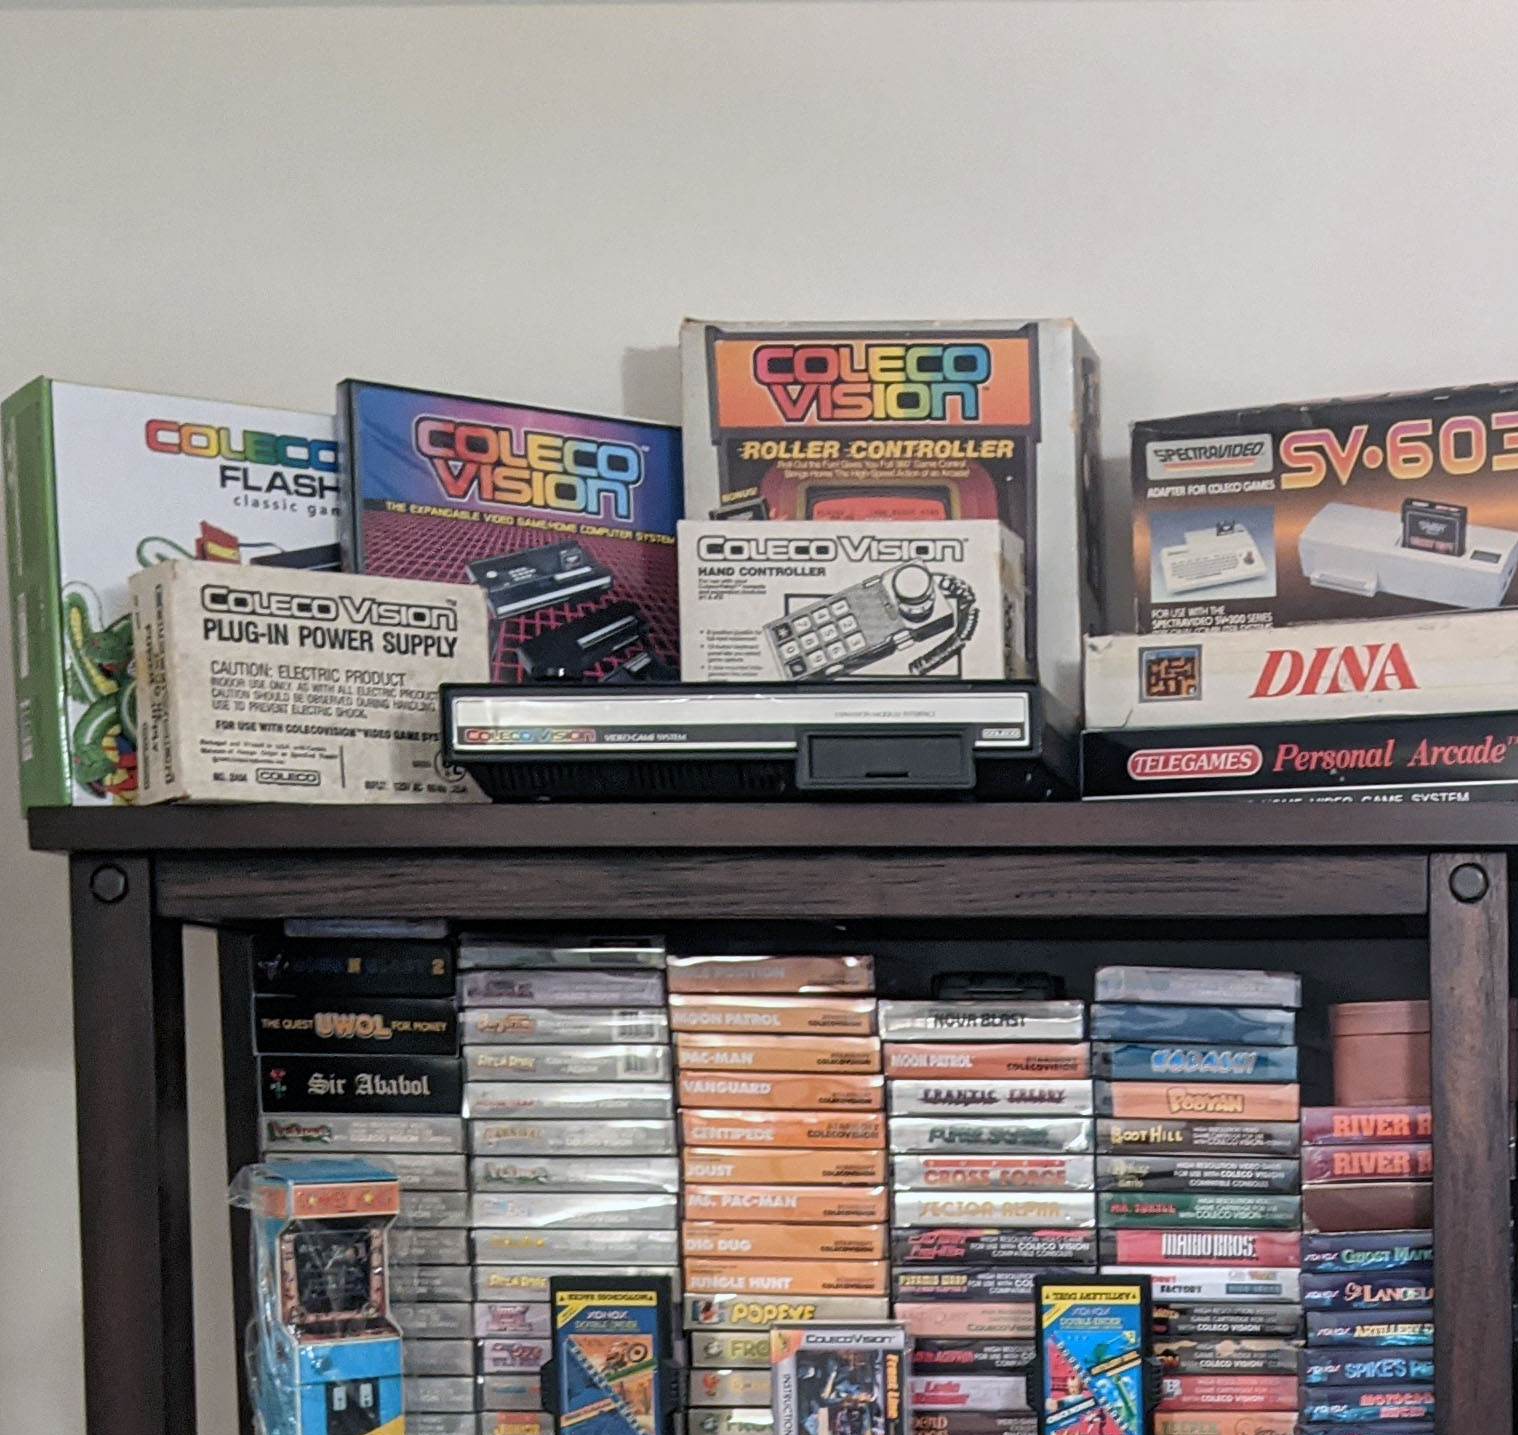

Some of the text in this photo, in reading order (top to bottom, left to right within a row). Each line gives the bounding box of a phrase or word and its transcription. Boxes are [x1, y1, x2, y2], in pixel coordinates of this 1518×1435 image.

[754, 343, 991, 383] COLECO
[768, 383, 978, 423] VISION
[416, 415, 644, 485] COLECO
[741, 440, 1014, 459] ROLLER CONTROLLER
[435, 457, 634, 521] VISION
[233, 495, 301, 514] classic
[386, 501, 675, 544] THE EXPANDABLE VIDEO COMPUTER SYSTEM
[699, 566, 826, 577] HAND CONTROLLER
[203, 620, 458, 658] PLUG-IN POWER SUPPLY
[278, 665, 406, 685] ELECTRIC PRODUCT
[1250, 643, 1420, 699] DINA
[1133, 740, 1394, 773] TELEGAMES Personal
[262, 1013, 446, 1039] THE QUEST UWOL FOR MONEY
[673, 1013, 780, 1026] MOON PATROL
[680, 1052, 754, 1065] PAC-MAN
[307, 1072, 430, 1096] Sir Ababol
[683, 1083, 773, 1095] VANGUARD
[1334, 1115, 1409, 1137] RIVER
[687, 1164, 734, 1177] JOUST
[923, 1170, 1067, 1186] CROSS FORCE
[722, 1194, 797, 1208] PAC-MAN
[686, 1239, 751, 1251] DIG DUG
[1161, 1233, 1212, 1257] MARIO
[748, 1276, 794, 1289] HUNT
[732, 1304, 817, 1323] POPEYE
[783, 1374, 794, 1434] INSTRUCTION
